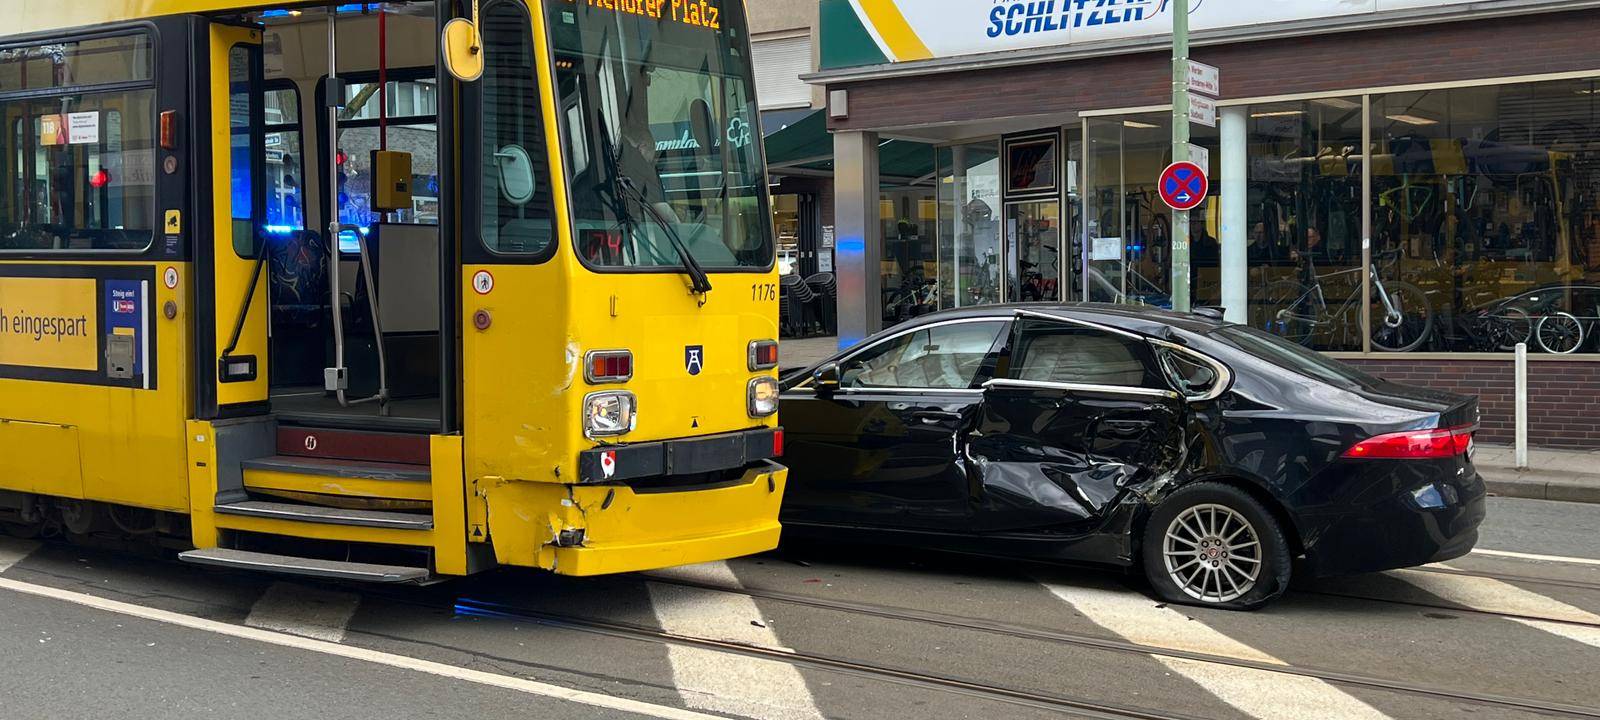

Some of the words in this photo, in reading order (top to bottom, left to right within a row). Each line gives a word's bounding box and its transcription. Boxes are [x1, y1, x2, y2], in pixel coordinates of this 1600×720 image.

[672, 0, 719, 29] Platz
[986, 0, 1146, 38] SCHLITZER
[1172, 240, 1187, 250] 200
[752, 283, 776, 302] 1176
[13, 309, 87, 342] eingespart
